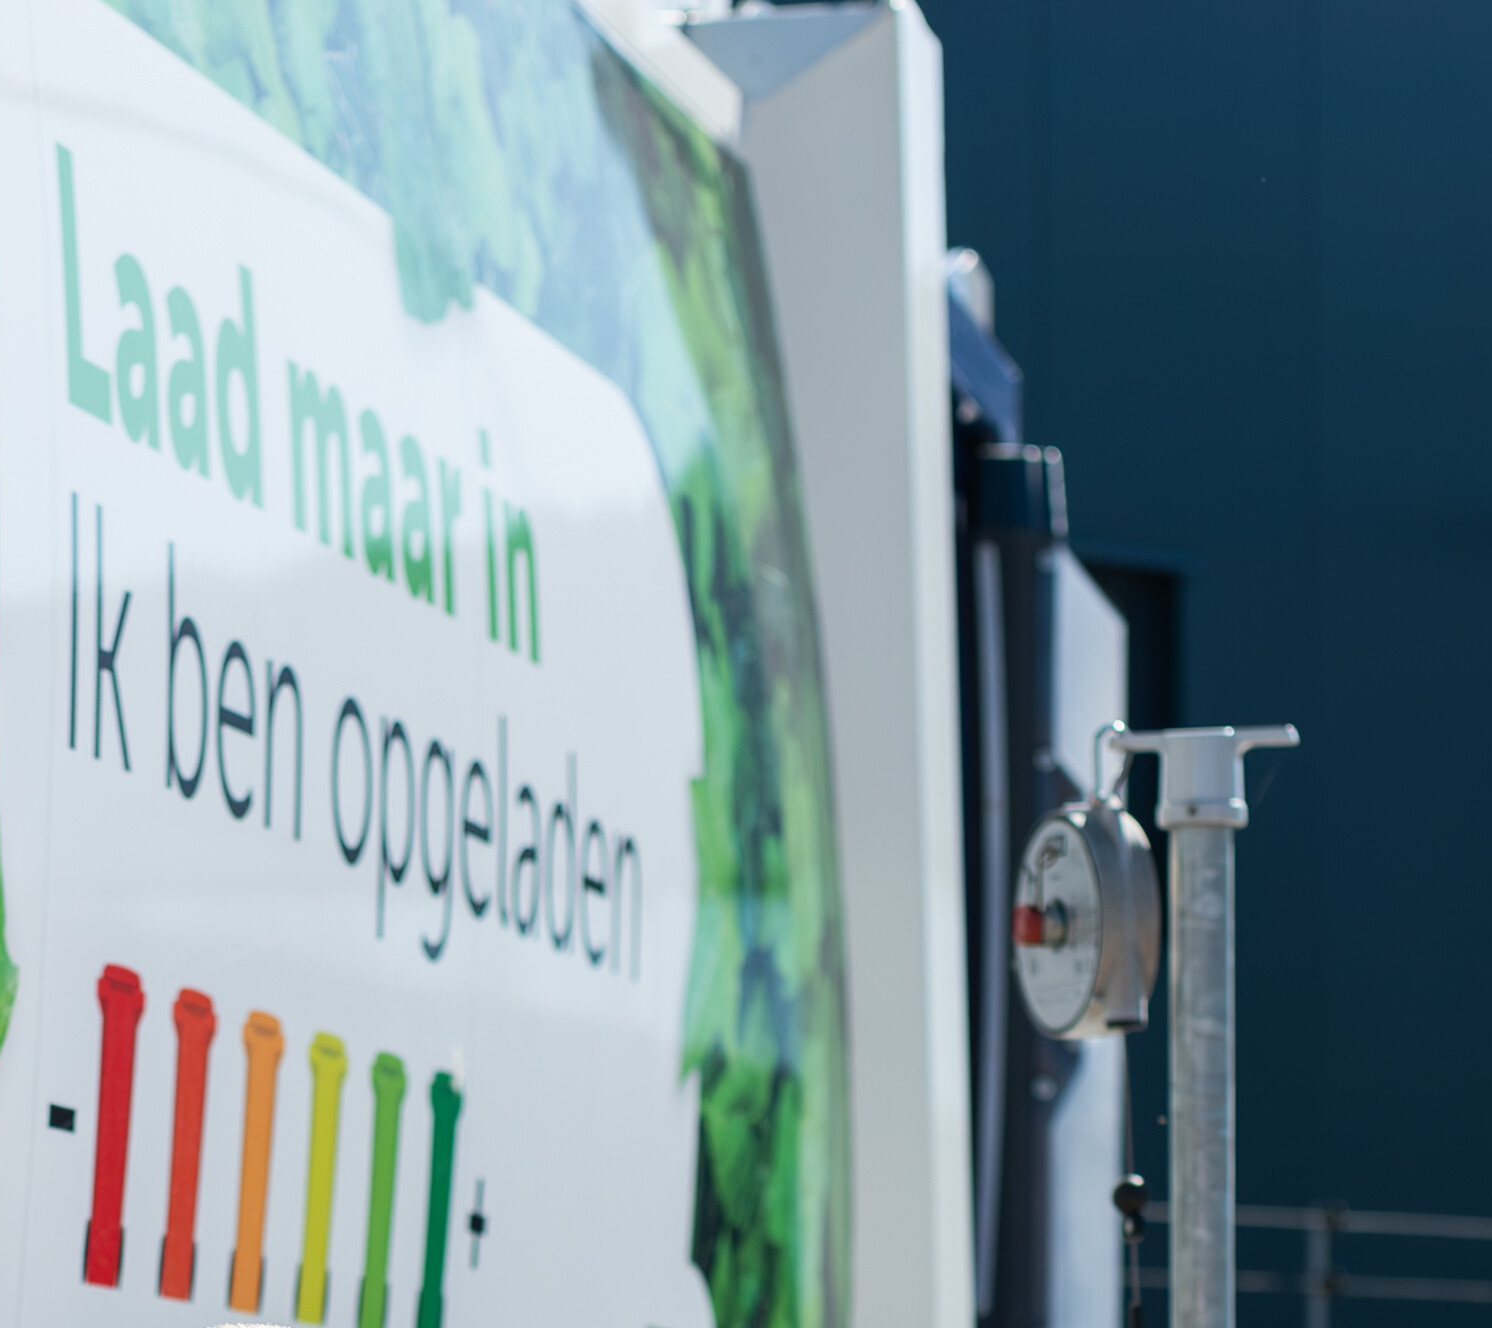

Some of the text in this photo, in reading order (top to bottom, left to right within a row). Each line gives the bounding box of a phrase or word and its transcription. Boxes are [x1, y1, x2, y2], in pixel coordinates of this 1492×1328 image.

[55, 143, 543, 666] Laad maar in
[68, 491, 646, 981] Ik ben opgeladen
